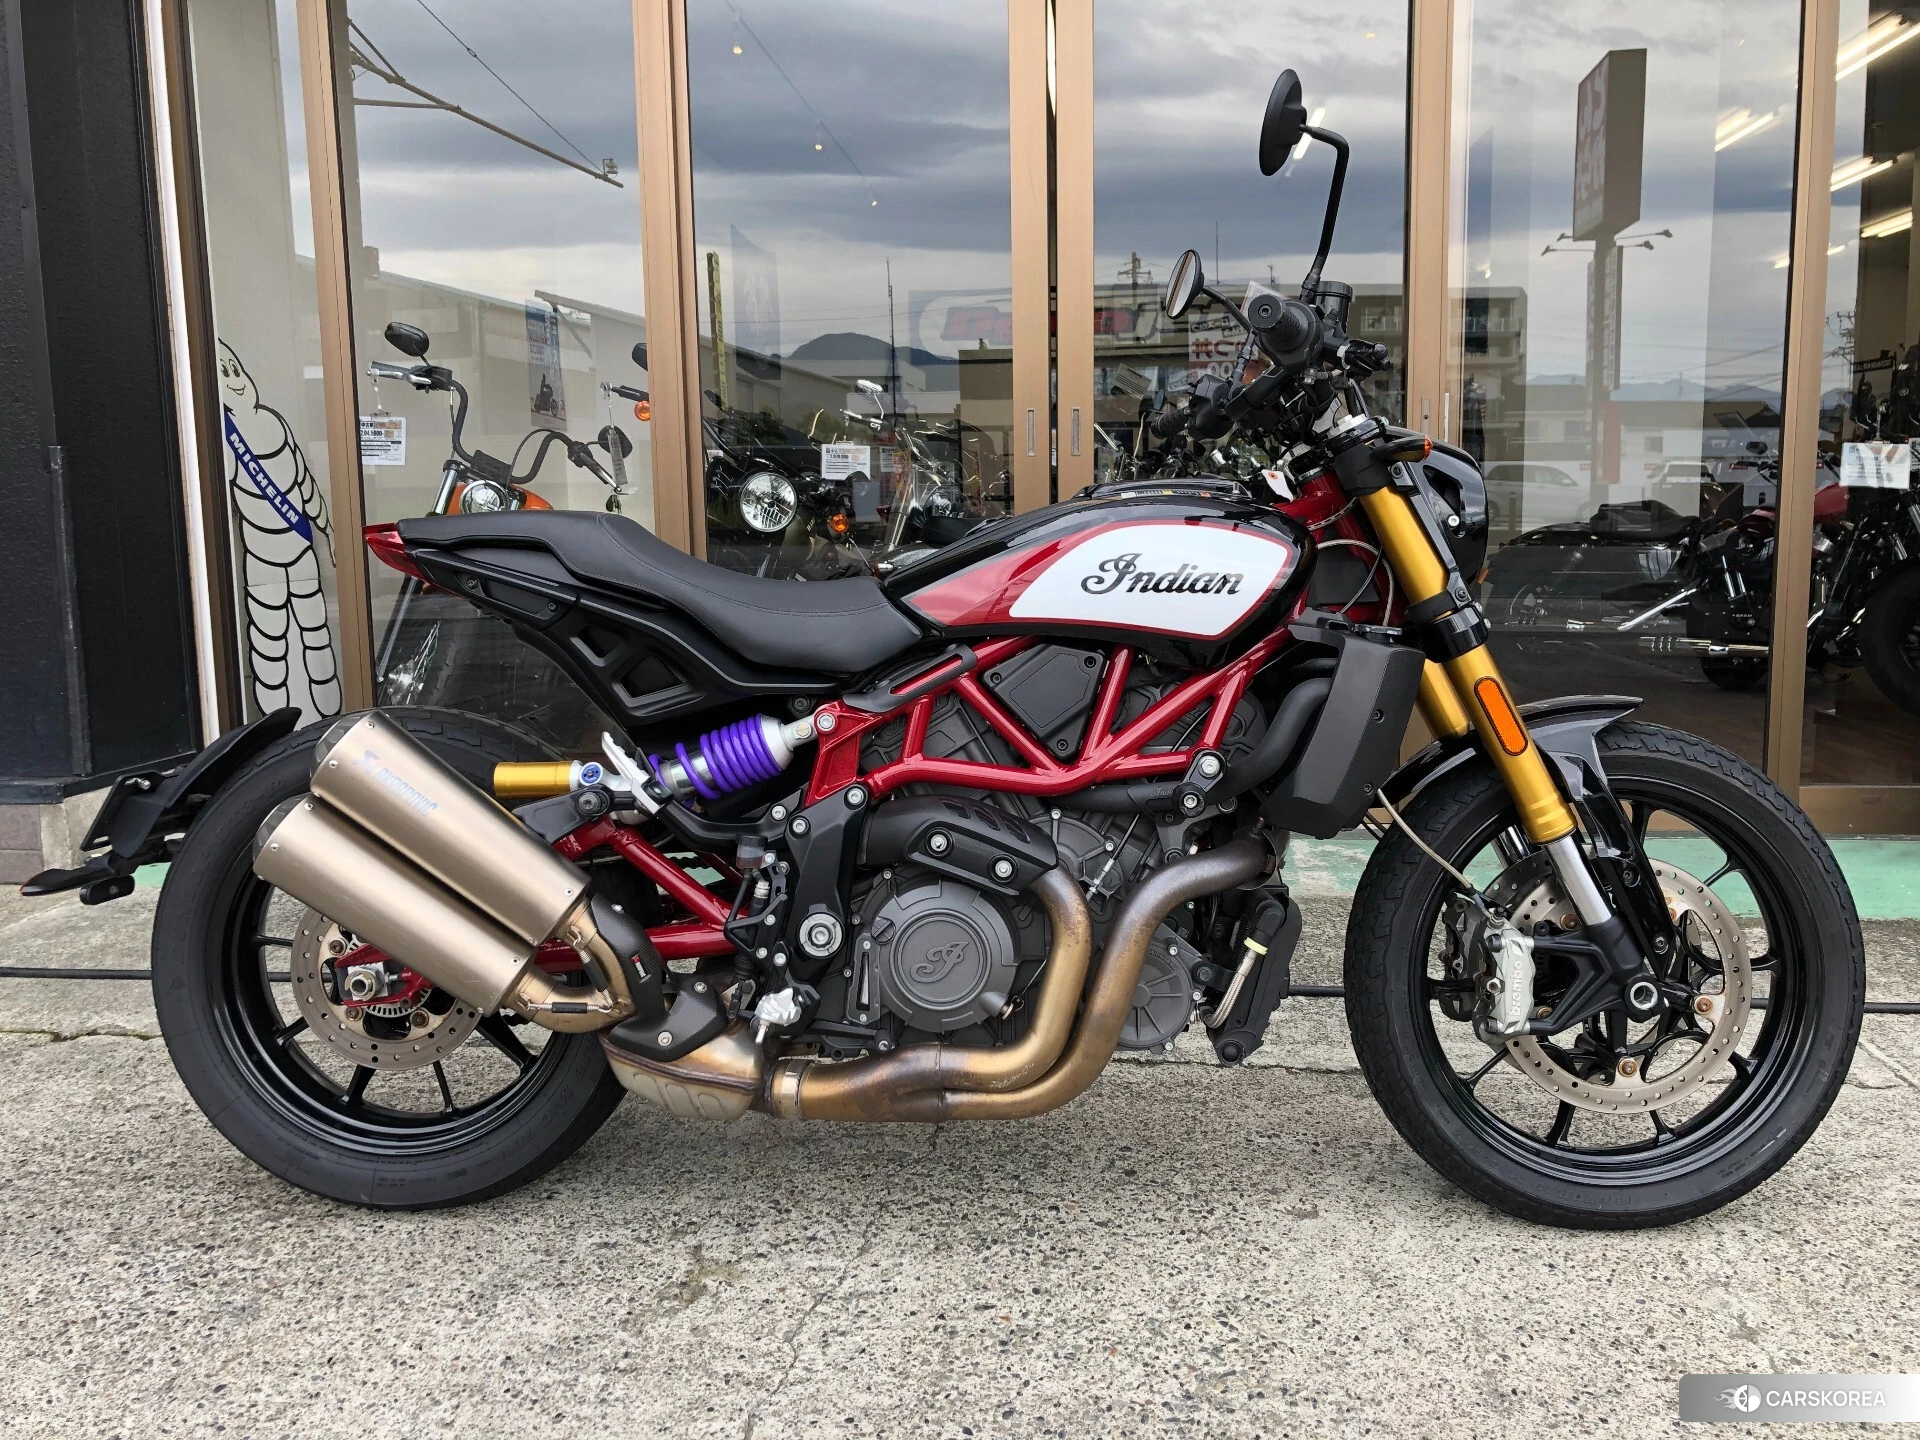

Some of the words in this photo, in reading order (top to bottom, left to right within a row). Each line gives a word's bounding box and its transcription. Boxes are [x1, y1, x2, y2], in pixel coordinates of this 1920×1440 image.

[229, 432, 299, 524] MICHELIN
[1081, 553, 1244, 594] Indian
[1508, 960, 1523, 1016] brembo
